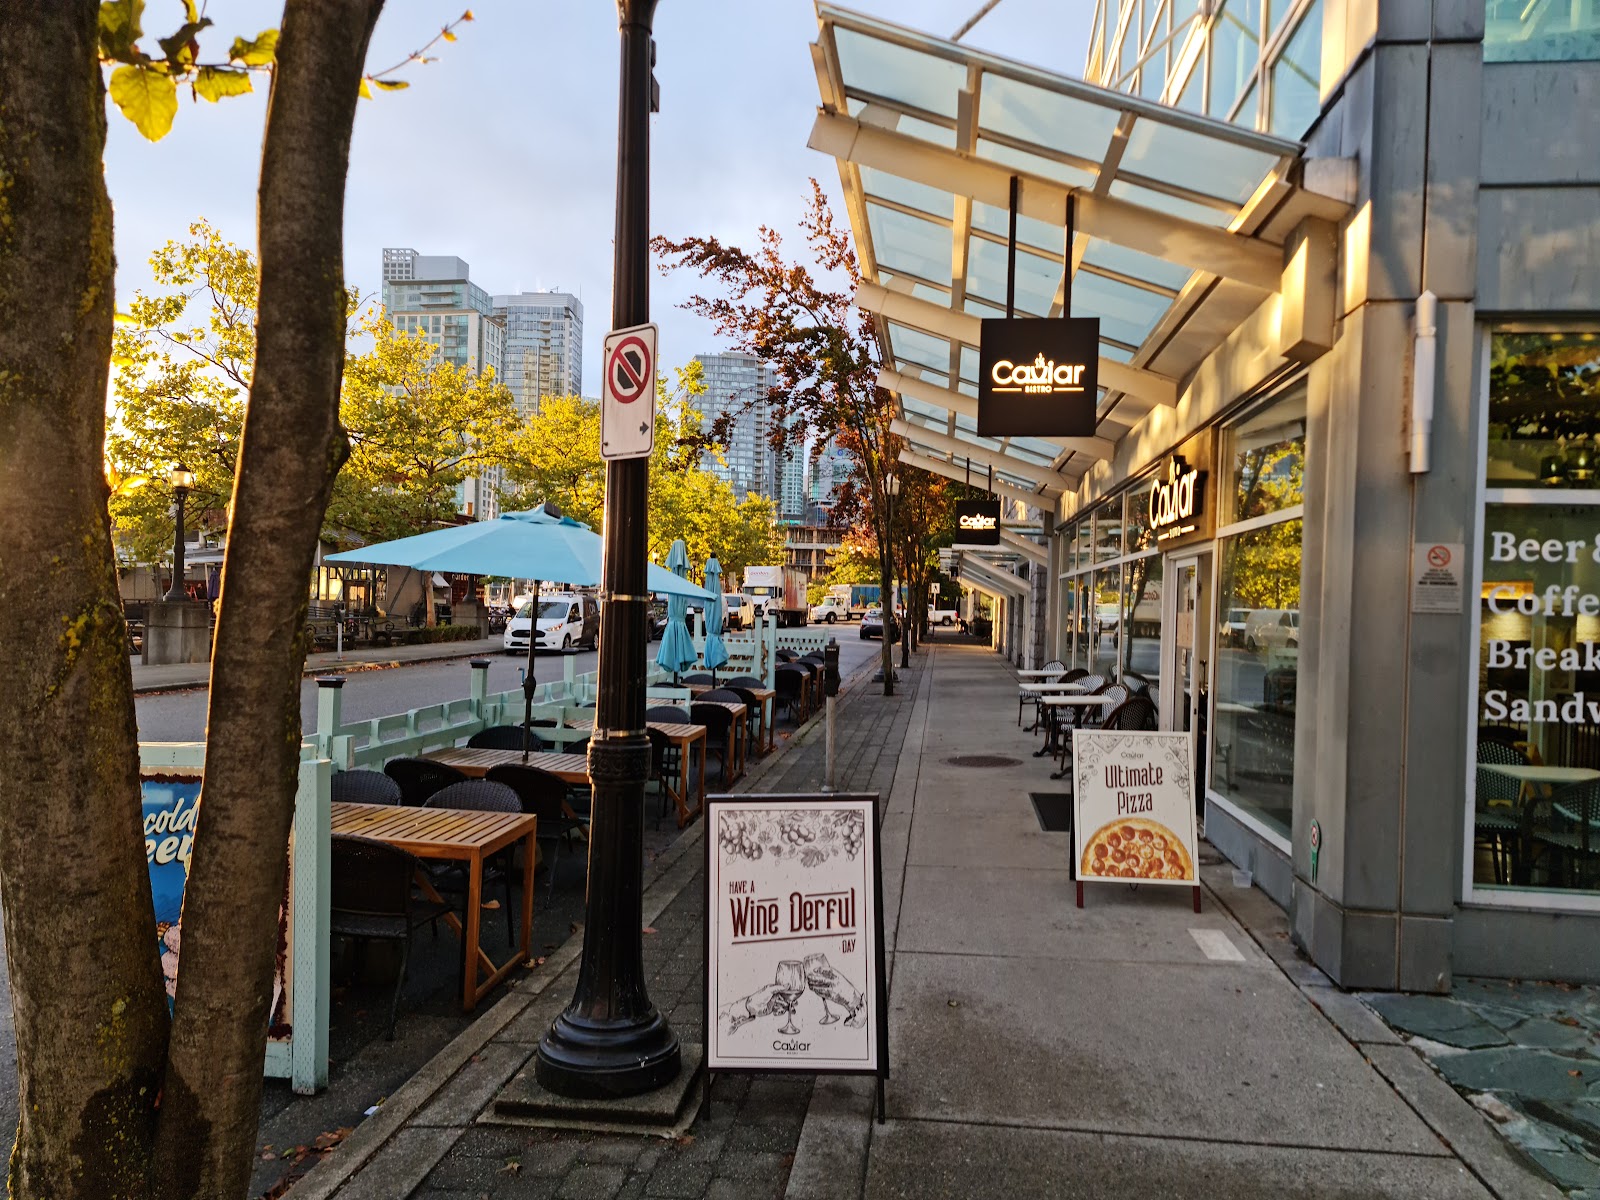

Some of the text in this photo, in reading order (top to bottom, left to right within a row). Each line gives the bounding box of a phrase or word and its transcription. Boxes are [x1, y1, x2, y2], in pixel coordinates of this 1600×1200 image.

[991, 359, 1086, 385] Caviar
[1149, 464, 1198, 530] Caviar
[959, 515, 997, 526] Caviar
[1490, 531, 1586, 563] Beer
[1487, 584, 1600, 617] Coffe
[1486, 639, 1600, 671] Break
[1105, 762, 1163, 789] Ultimate
[144, 797, 201, 836] cold
[1117, 790, 1153, 816] Pizza
[728, 879, 756, 895] HAVE A
[729, 887, 856, 938] Wine Derful
[841, 938, 857, 954] DAY
[772, 1040, 812, 1051] Caviar
